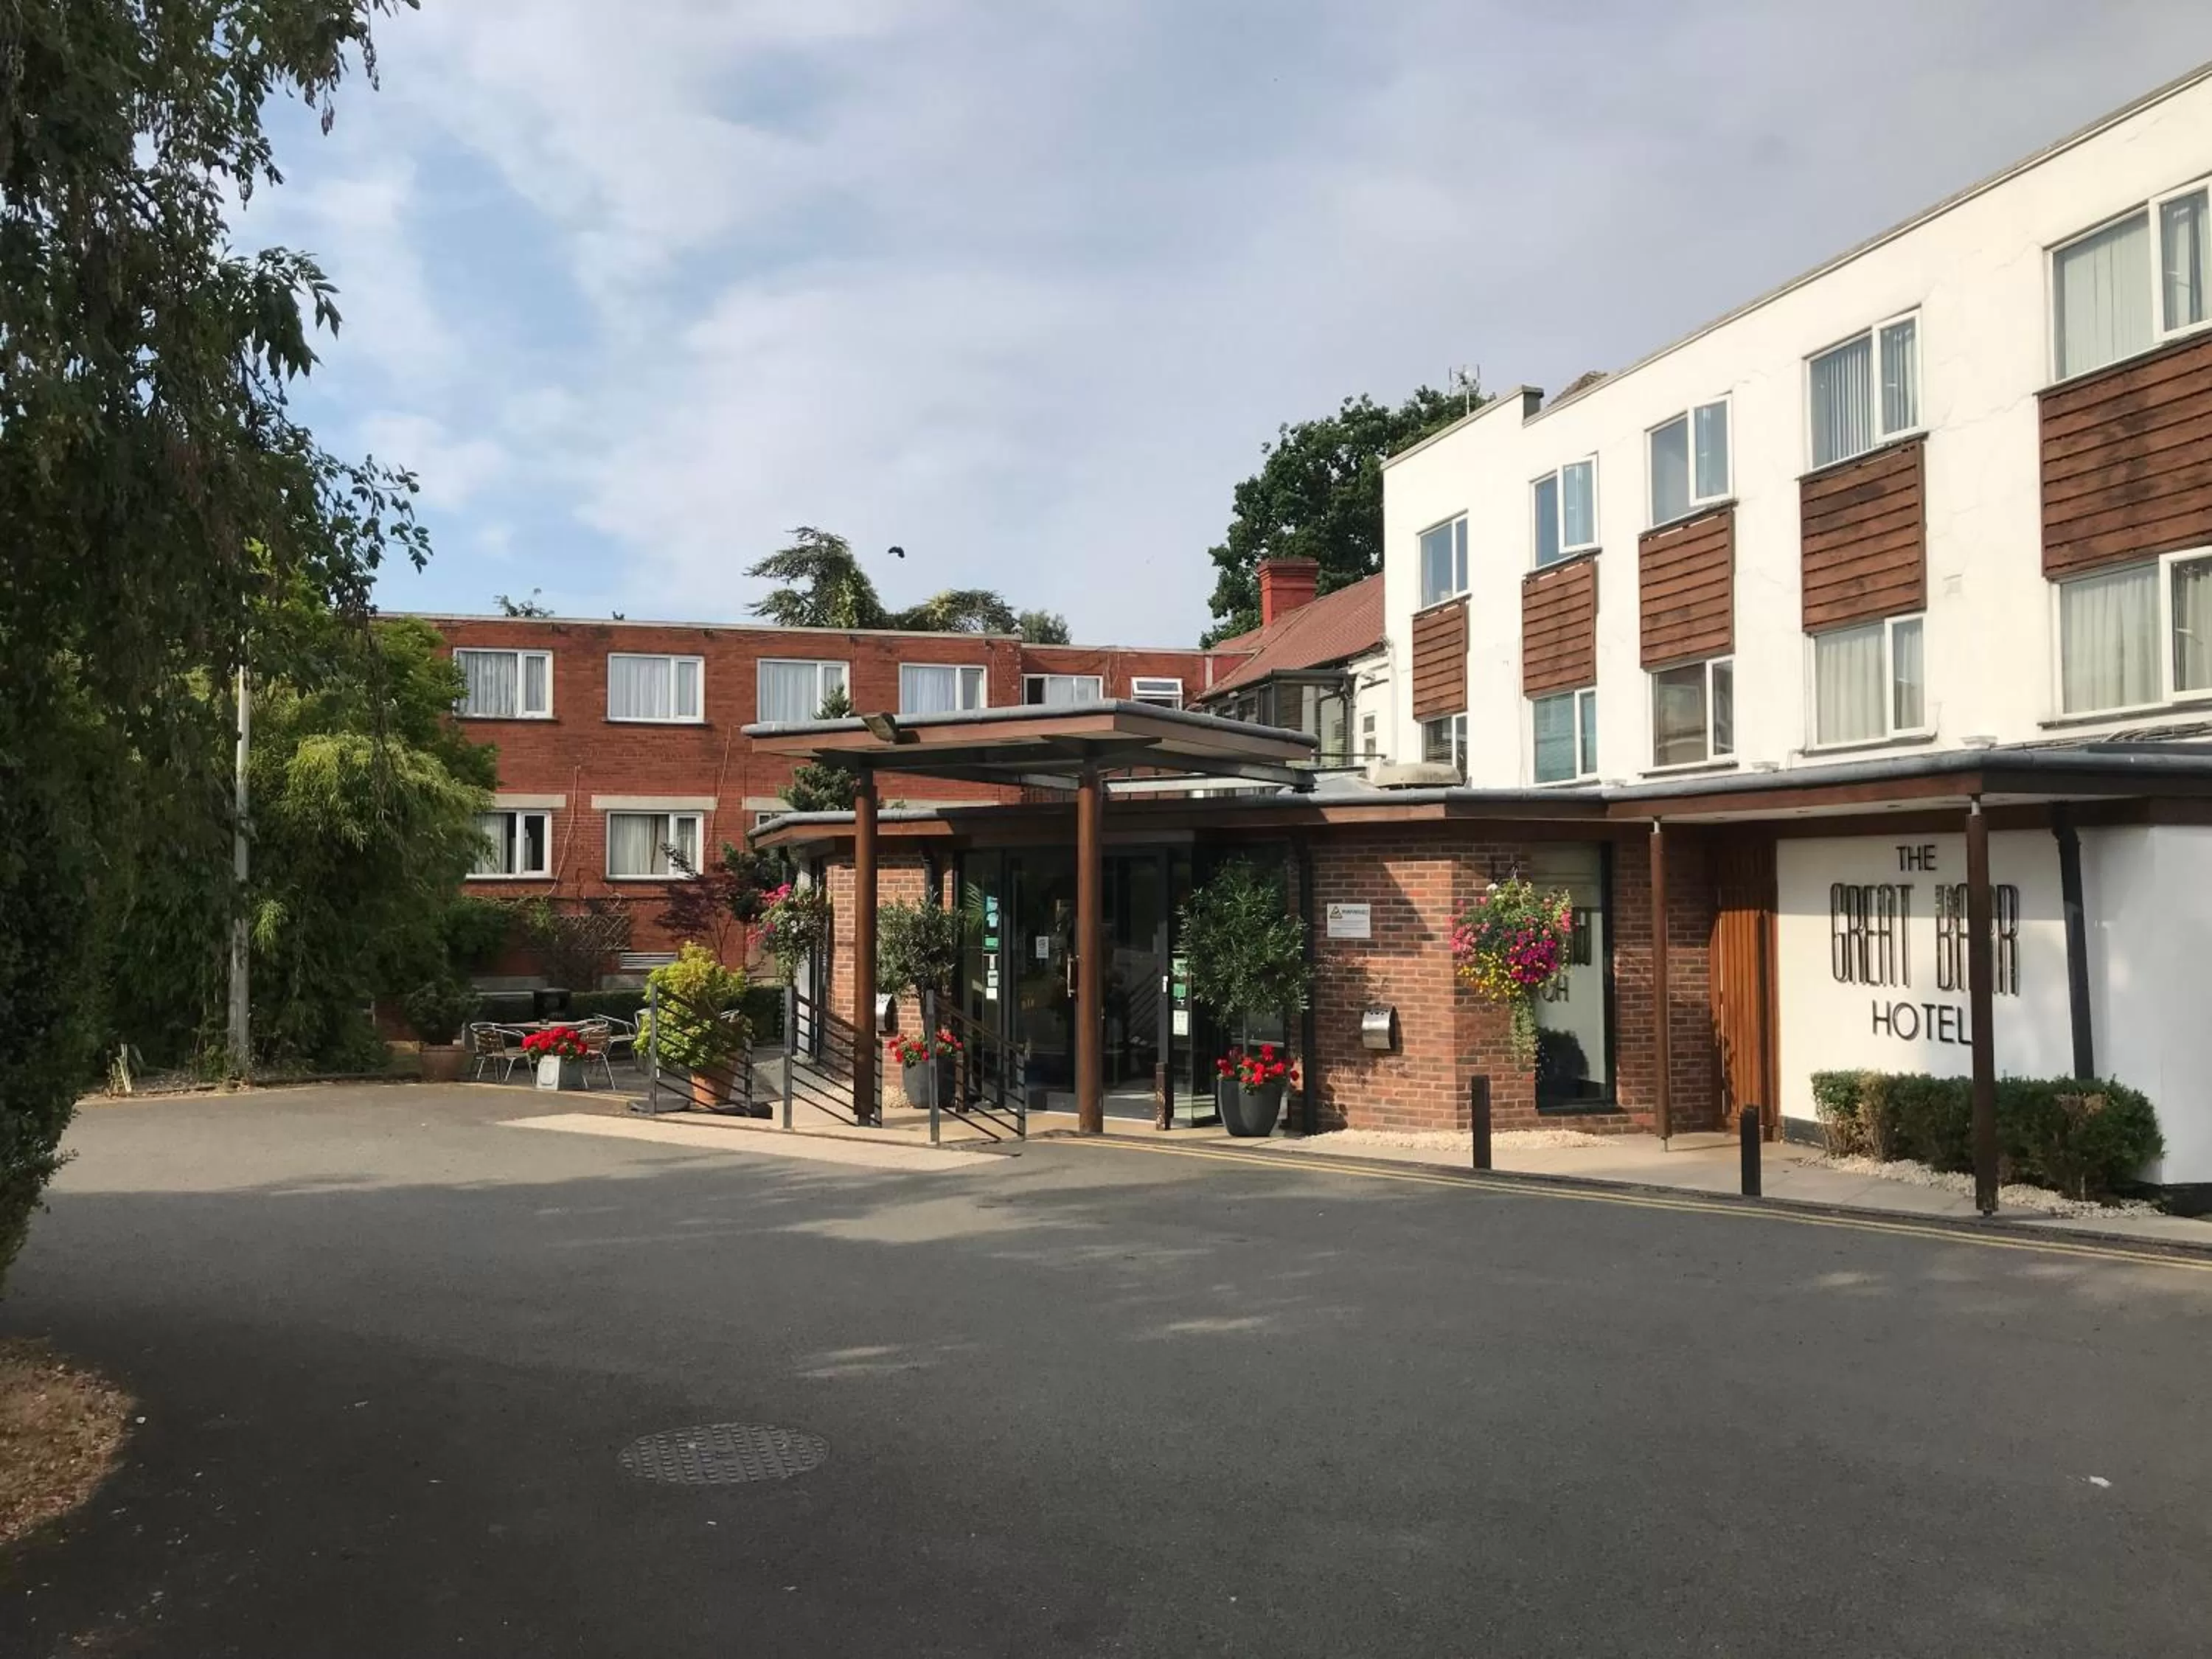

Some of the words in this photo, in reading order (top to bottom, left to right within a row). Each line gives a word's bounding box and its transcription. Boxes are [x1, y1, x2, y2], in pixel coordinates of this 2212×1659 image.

[1896, 844, 1937, 871] THE
[1830, 883, 1914, 987] GREAT
[1935, 883, 2020, 995] BAR
[1872, 1000, 1972, 1046] HOTEL
